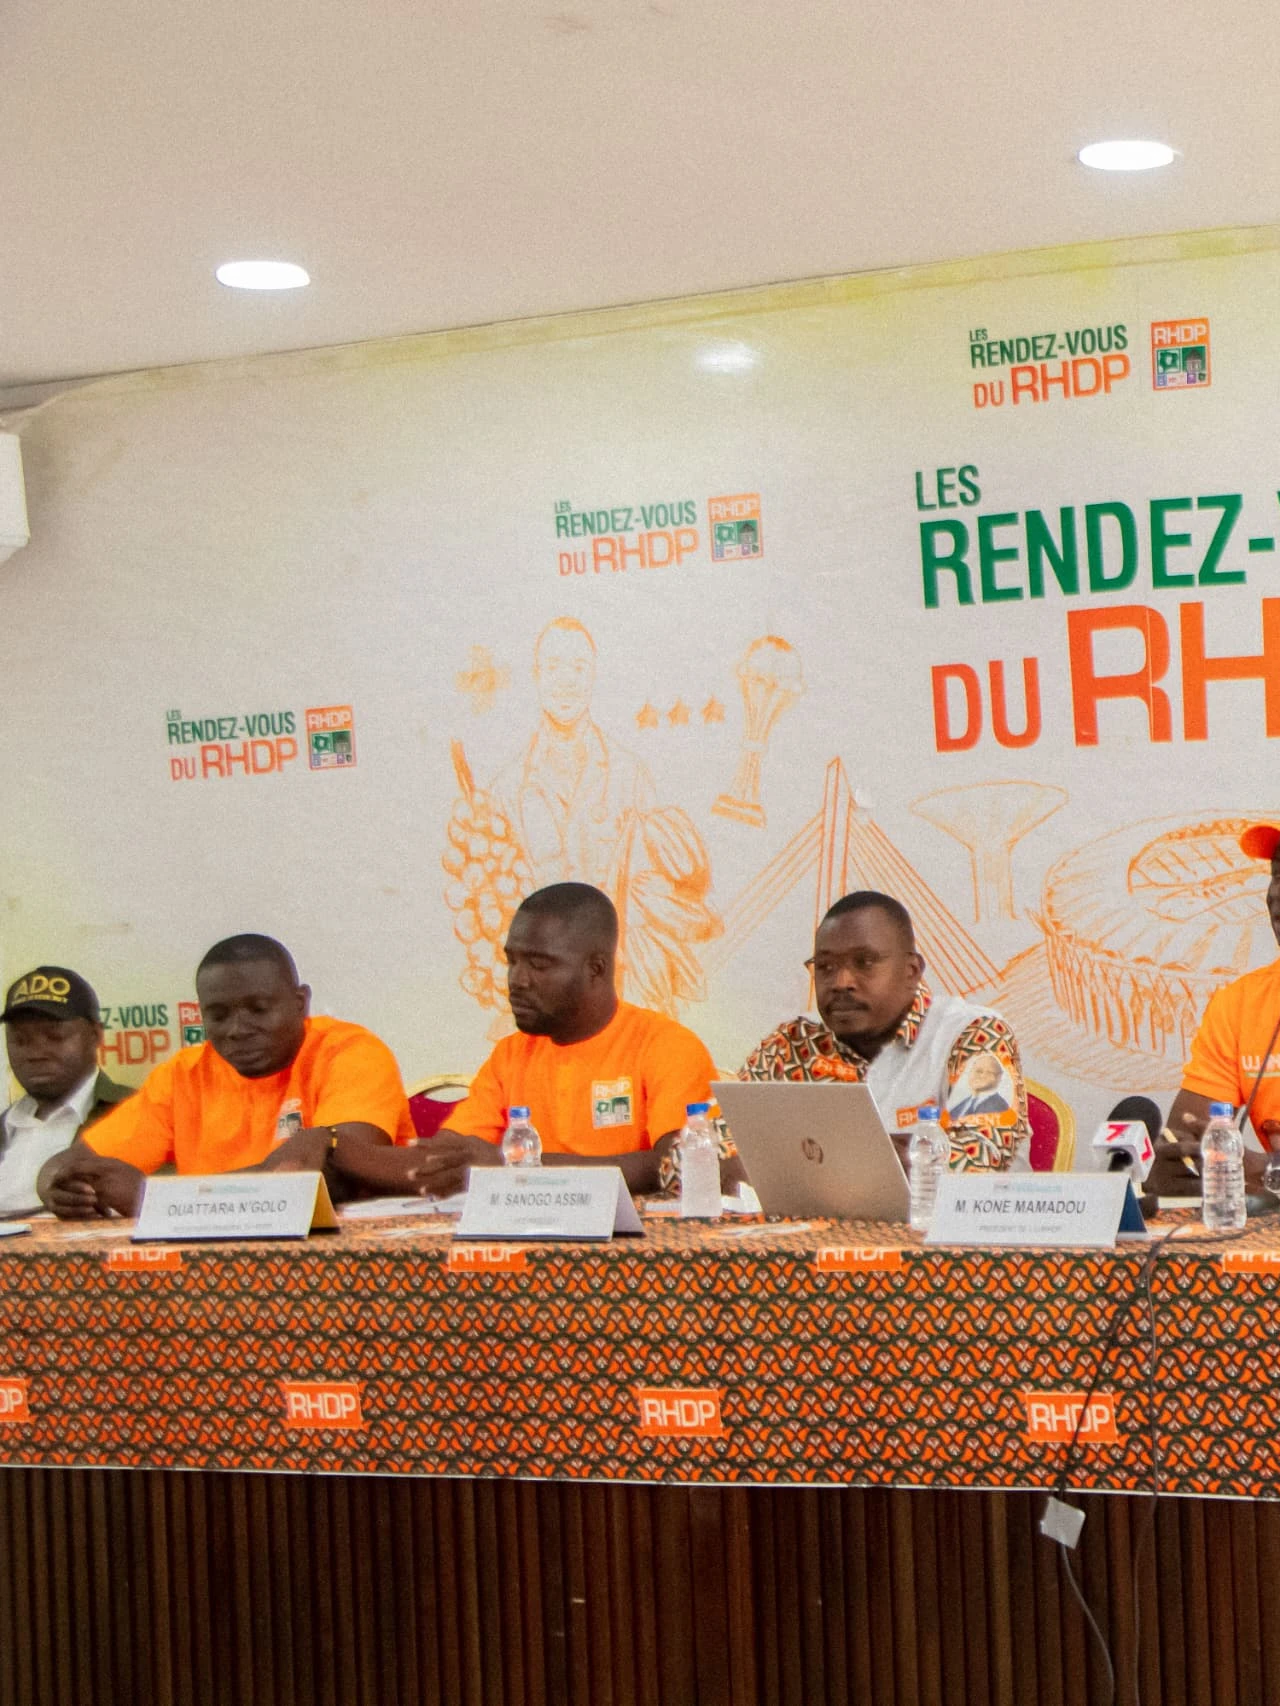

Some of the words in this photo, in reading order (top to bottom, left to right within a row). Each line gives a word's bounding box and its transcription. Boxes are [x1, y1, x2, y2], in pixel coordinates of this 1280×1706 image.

[969, 329, 988, 342] LES
[970, 324, 1128, 368] RENDEZ-VOUS
[1154, 325, 1207, 344] RHDP
[973, 380, 1004, 408] DU
[1010, 354, 1131, 405] RHDP
[915, 465, 981, 511] LES
[556, 501, 697, 538] RENDEZ-VOUS
[711, 500, 760, 519] RHDP
[559, 551, 586, 576] DU
[592, 528, 700, 574] RHDP
[931, 657, 1042, 753] DU
[168, 711, 296, 745] RENDEZ-VOUS
[309, 712, 351, 728] RHDP
[171, 757, 197, 780] DU
[201, 737, 298, 780] RHDP
[14, 975, 71, 999] ADO
[167, 1202, 235, 1217] OUATTARA
[239, 1200, 287, 1213] N'GOLO
[504, 1193, 552, 1206] SANOGO
[954, 1200, 969, 1213] M.
[973, 1200, 1011, 1213] KONE
[1014, 1200, 1086, 1214] MAMADOU
[289, 1391, 356, 1419] RHDP
[645, 1399, 716, 1428] RHDP
[1031, 1403, 1110, 1433] RHDP
